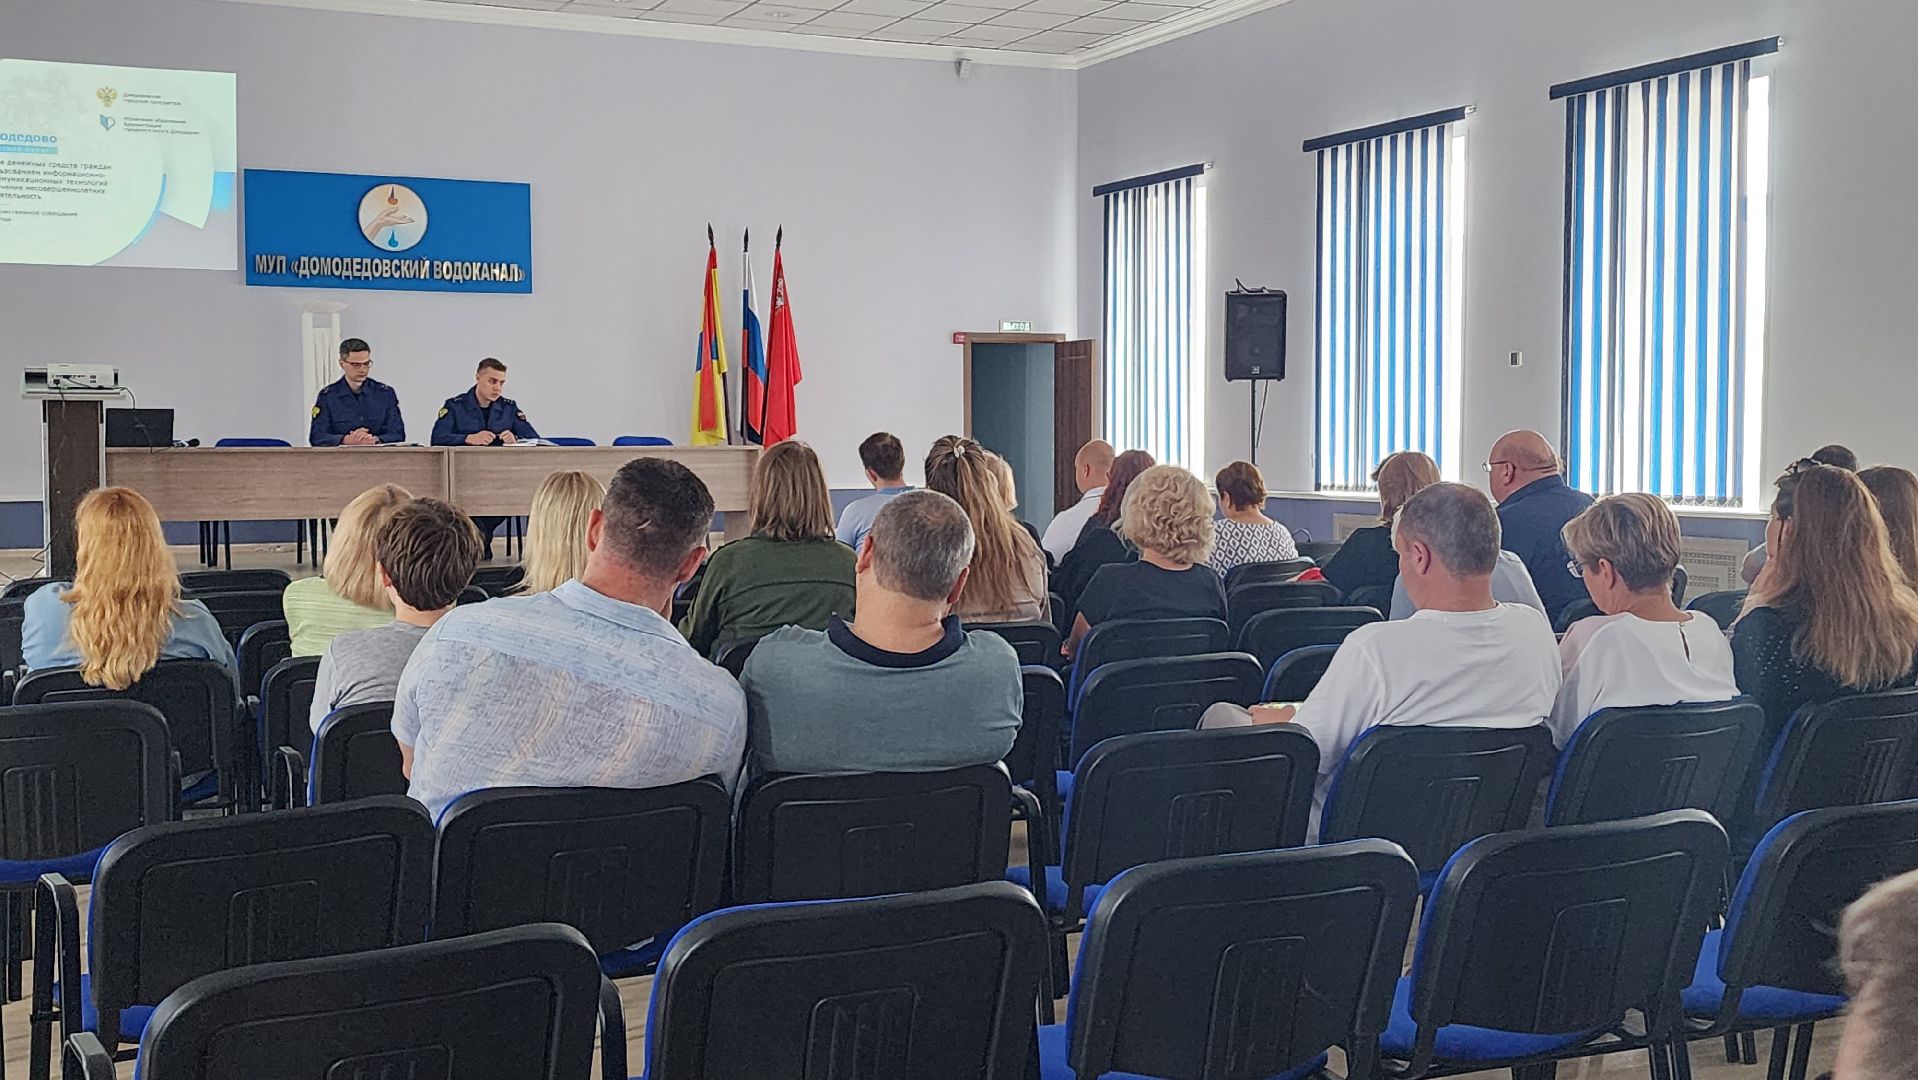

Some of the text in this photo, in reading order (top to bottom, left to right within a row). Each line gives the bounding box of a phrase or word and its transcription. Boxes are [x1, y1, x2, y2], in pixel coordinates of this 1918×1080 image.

[0, 133, 58, 144] одедово
[66, 179, 108, 187] технологий
[255, 254, 526, 283] МУП «ДОМОДЕДОВСКИЙ ВОДОКАНАЛ»
